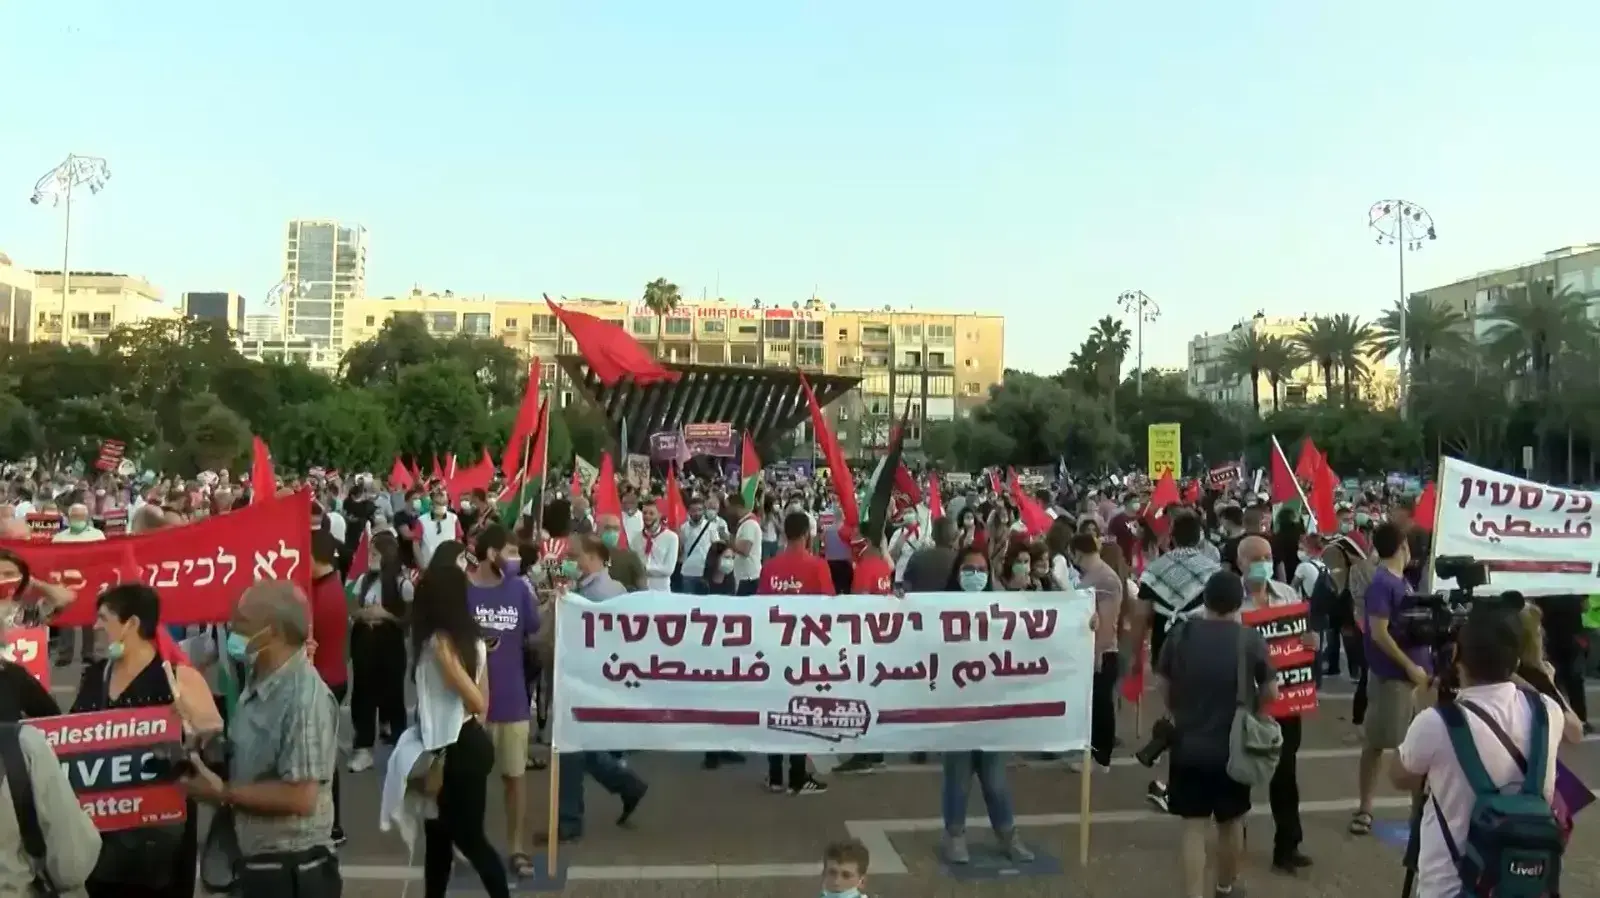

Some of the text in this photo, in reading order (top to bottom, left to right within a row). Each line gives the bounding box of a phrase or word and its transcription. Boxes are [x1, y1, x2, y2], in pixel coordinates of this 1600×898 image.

[1470, 511, 1592, 543] فلسطين
[253, 540, 299, 581] לא
[581, 604, 1058, 649] שלום ישראל פלסטין
[602, 647, 1049, 692] سلام إسرائيل فلسطين
[82, 796, 143, 818] atter
